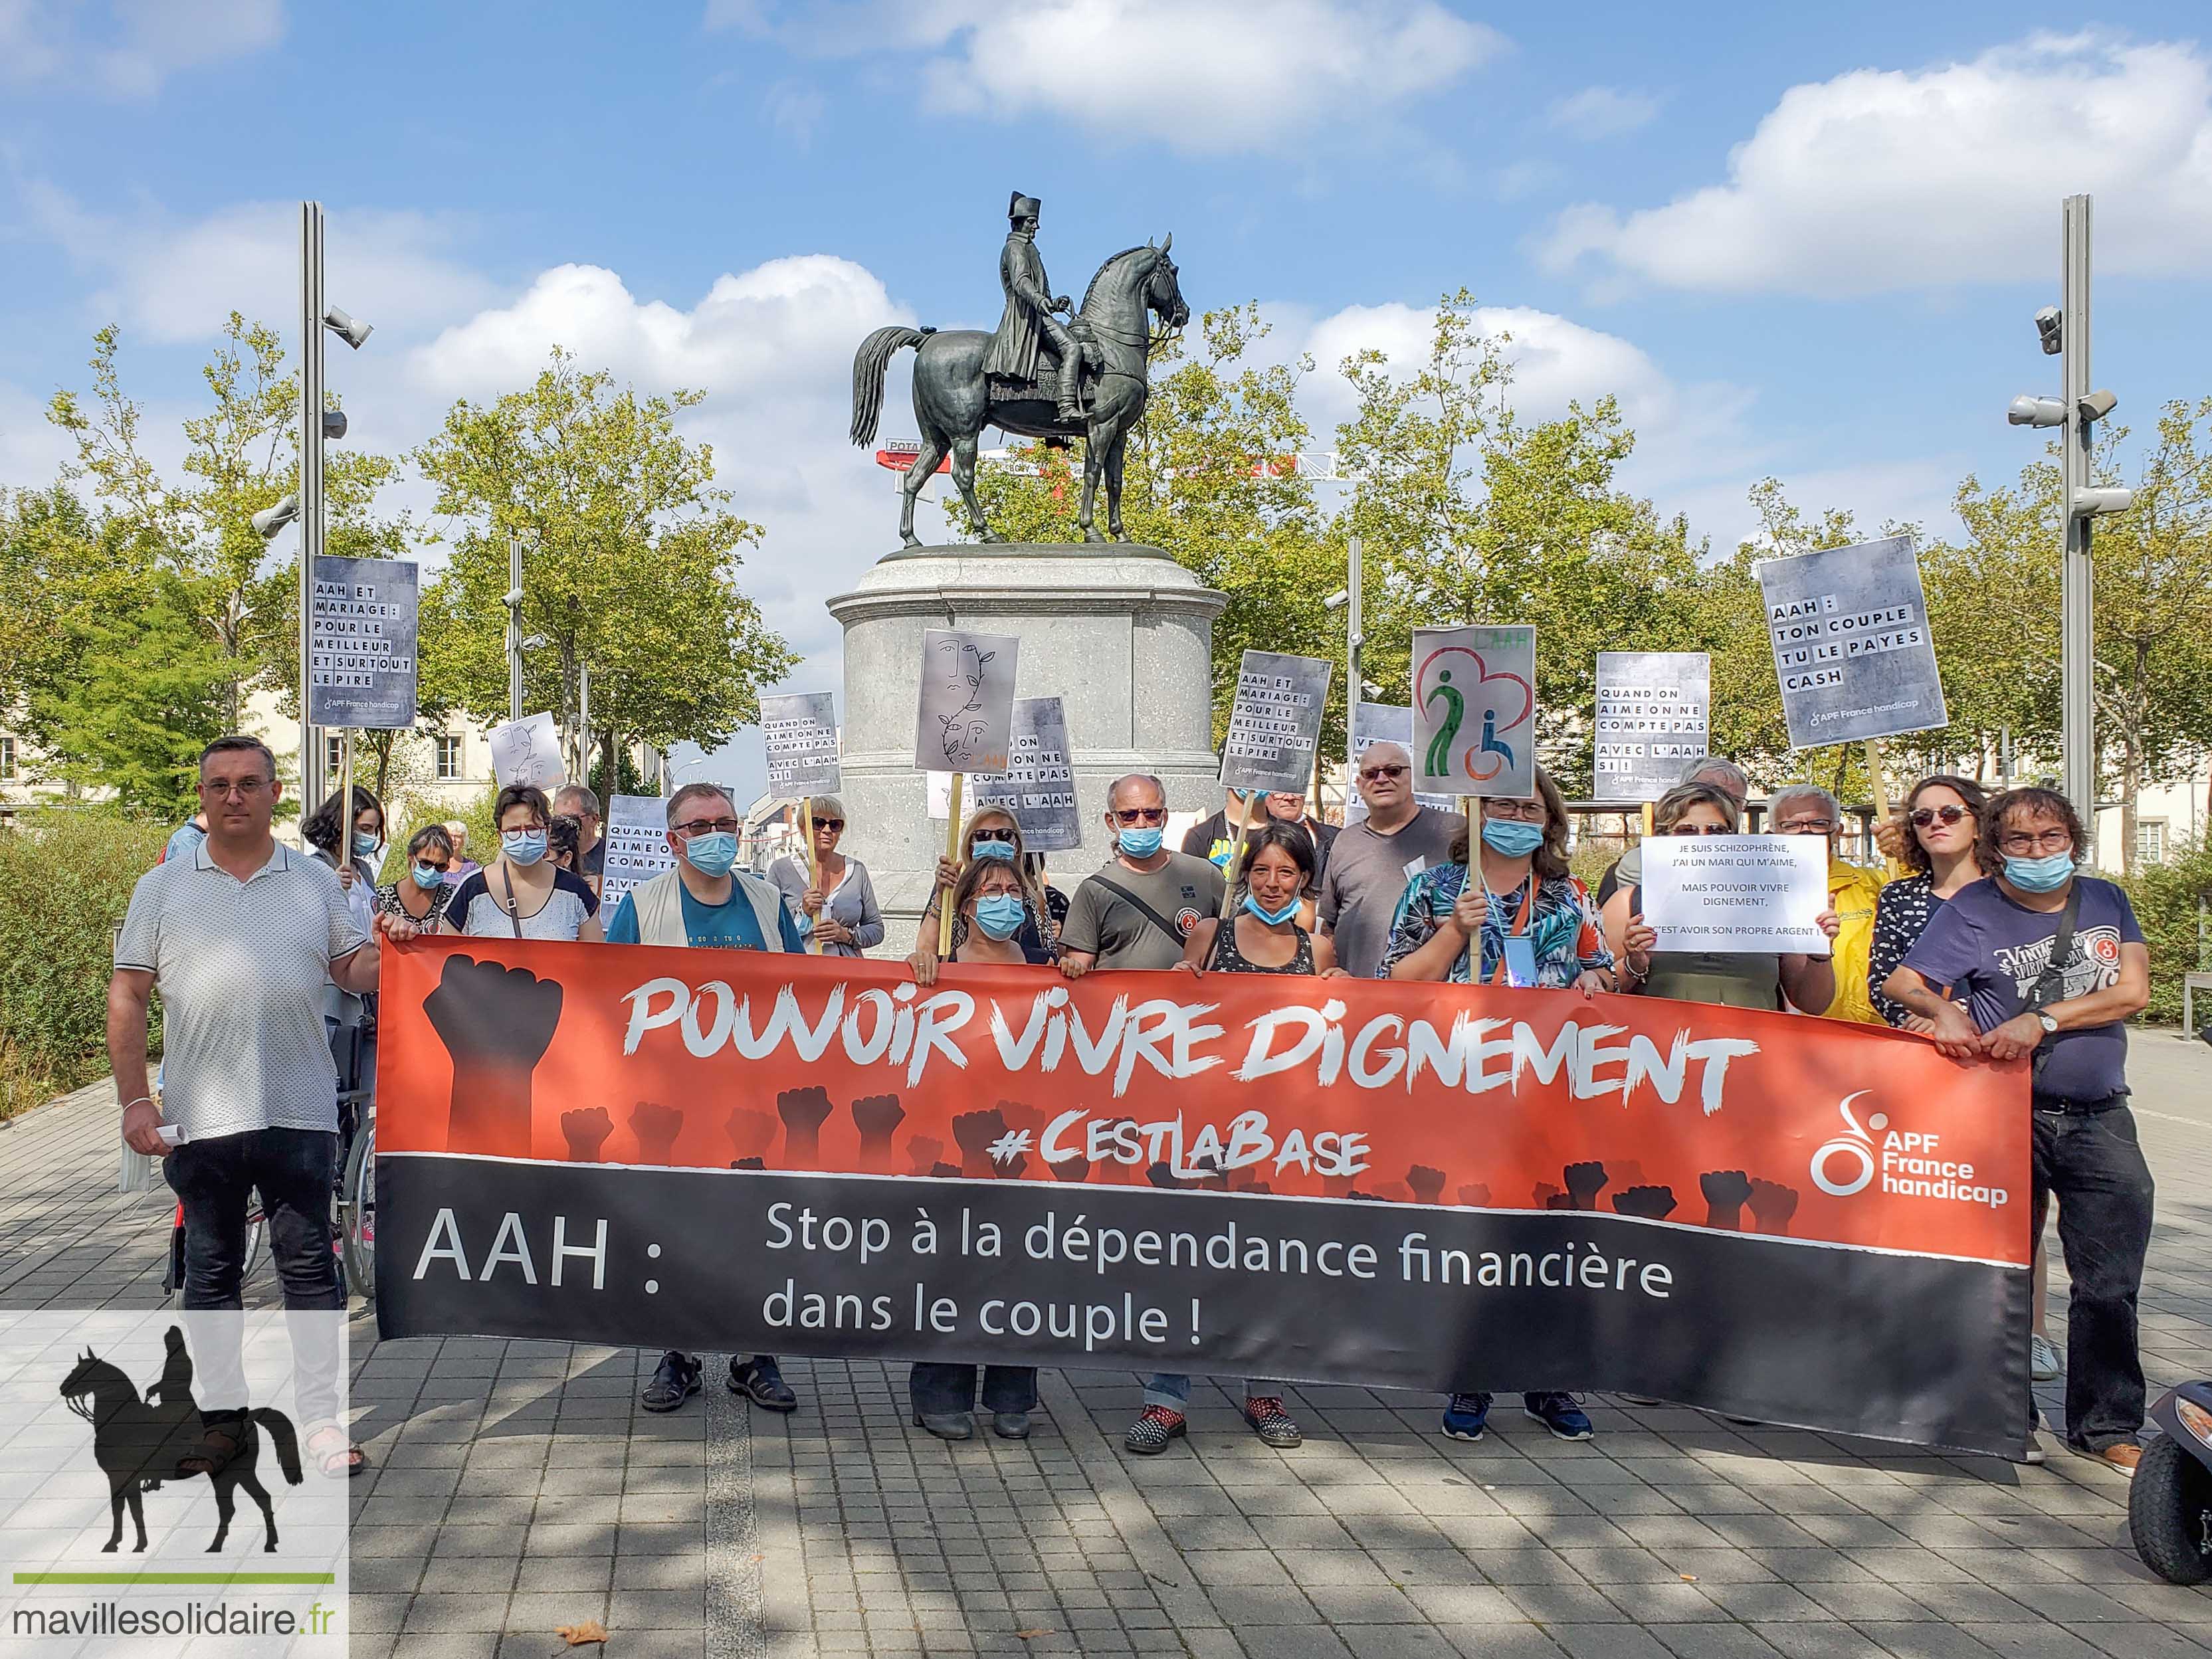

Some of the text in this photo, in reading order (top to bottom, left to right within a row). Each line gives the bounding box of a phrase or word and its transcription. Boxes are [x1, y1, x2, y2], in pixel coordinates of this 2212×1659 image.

[316, 584, 374, 598] AAH ET
[1773, 599, 1833, 620] AAH :
[314, 621, 380, 634] POUR LE
[1777, 609, 1906, 641] TON COUPLE
[314, 639, 389, 652] MEILLEUR
[1782, 631, 1919, 664] TU LE PAYES
[314, 656, 409, 670] ET SURTOUT
[314, 674, 371, 686] LE PIRE
[1242, 674, 1291, 688] AAH ET
[1787, 670, 1841, 690] CASH
[1601, 689, 1652, 698] QUAND
[368, 700, 399, 710] handicap
[1237, 704, 1291, 718] POUR LE
[1600, 705, 1699, 715] AIME ON NE
[1820, 699, 1919, 722] APF France handicap
[765, 721, 798, 730] QUAND
[1233, 718, 1296, 733] MEILLEUR
[1599, 721, 1704, 731] COMPTE PAS
[766, 732, 793, 741] AIME
[1019, 737, 1037, 747] ON
[1231, 732, 1311, 748] ET SURTOUT
[767, 741, 811, 751] COMPTE
[1229, 745, 1278, 759] LE PIRE
[1599, 745, 1704, 756] AVEC L'AAH
[769, 756, 837, 769] AVEC L'AAH
[1014, 753, 1060, 764] ON NE
[1599, 761, 1613, 770] SI
[1039, 769, 1068, 779] PAS
[1025, 795, 1073, 806] L'AAH
[611, 827, 663, 837] QUAND
[1035, 827, 1064, 836] handicap
[609, 842, 652, 852] AIME
[1679, 844, 1690, 853] JE
[1714, 842, 1790, 854] SCHIZOPHRÈNE,
[1672, 858, 1688, 867] J'AI
[1708, 858, 1734, 867] MARI
[1736, 858, 1754, 868] QUI
[1756, 858, 1797, 868] M'AIME,
[1682, 883, 1789, 892] MAIS POUVOIR VIVRE
[1703, 898, 1769, 908] DIGNEMENT,
[1680, 926, 1710, 935] AVOIR
[1712, 926, 1732, 935] SON
[1735, 926, 1774, 935] PROPRE
[1775, 927, 1815, 936] ARGENT
[1882, 1130, 2009, 1209] APF France handicap
[412, 1207, 662, 1295] AAH :
[765, 1202, 1674, 1298] Stop à la dépendance financière
[762, 1278, 1201, 1351] dans le couple !
